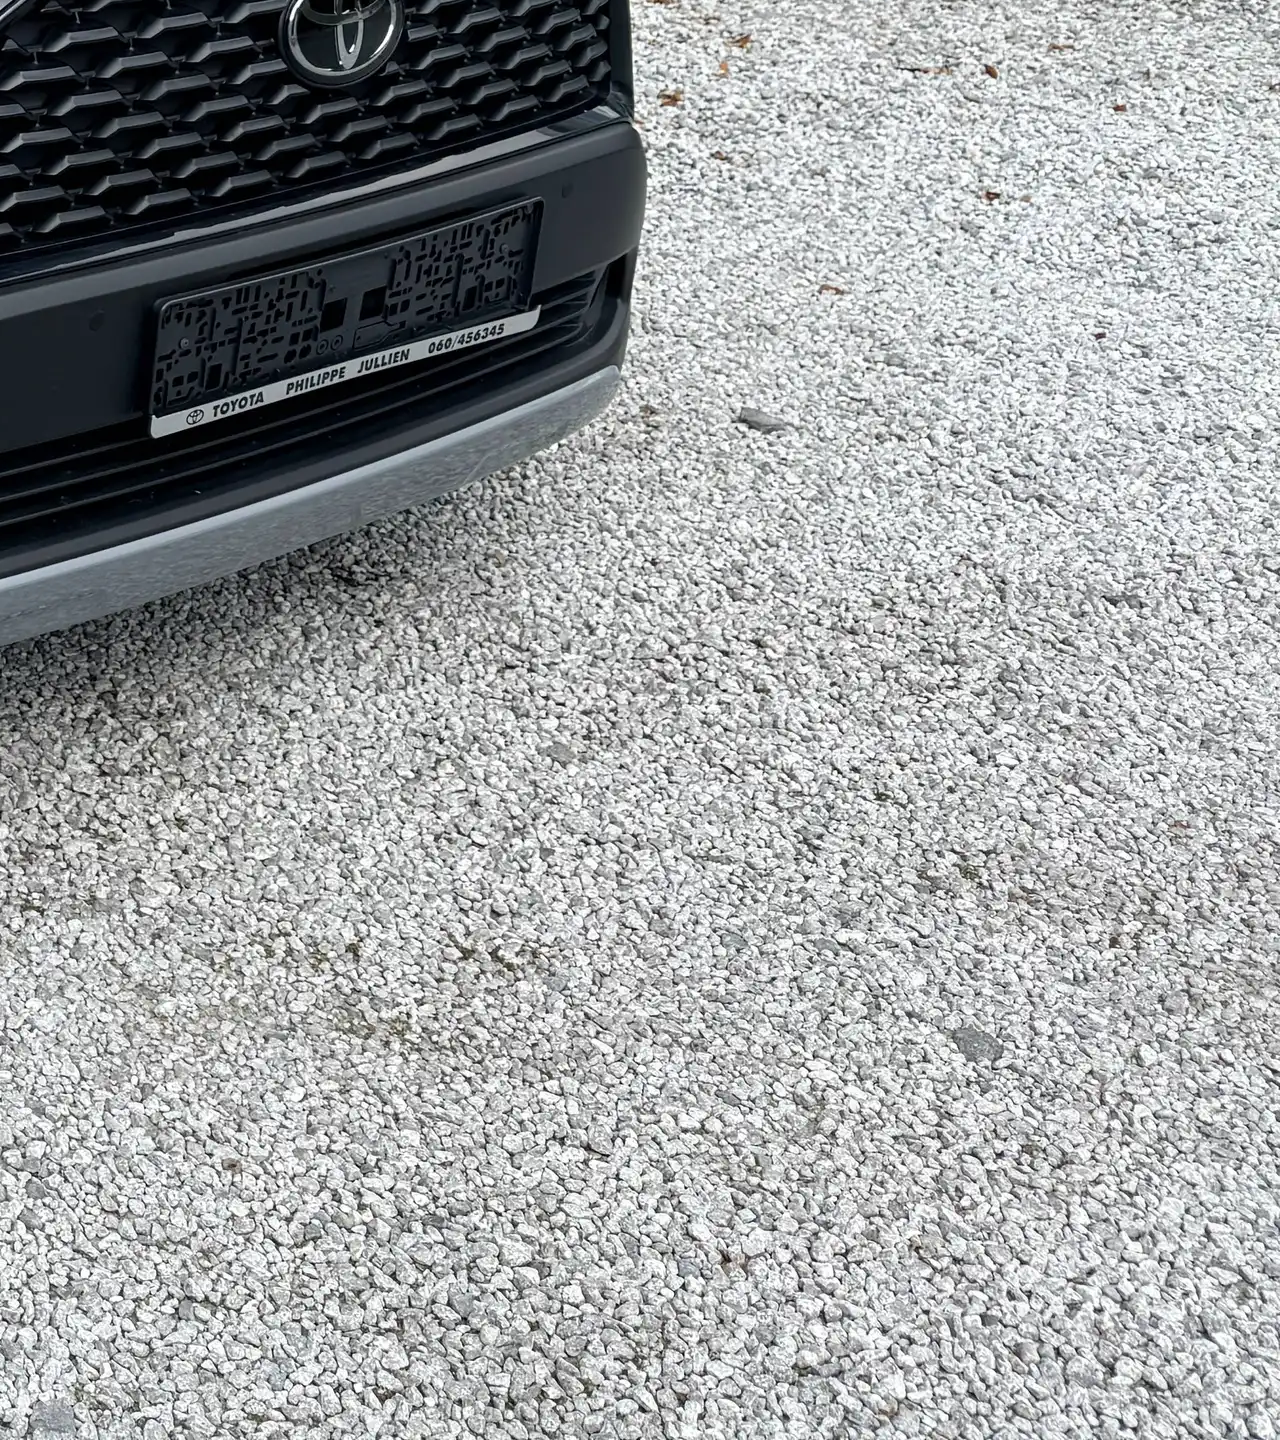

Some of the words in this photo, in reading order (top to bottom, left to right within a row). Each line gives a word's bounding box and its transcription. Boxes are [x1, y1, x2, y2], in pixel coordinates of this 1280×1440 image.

[212, 391, 265, 418] TOYOTA
[285, 366, 347, 396] PHILIPPE
[357, 348, 410, 374] JULLIEN
[428, 323, 505, 354] 060/456345
